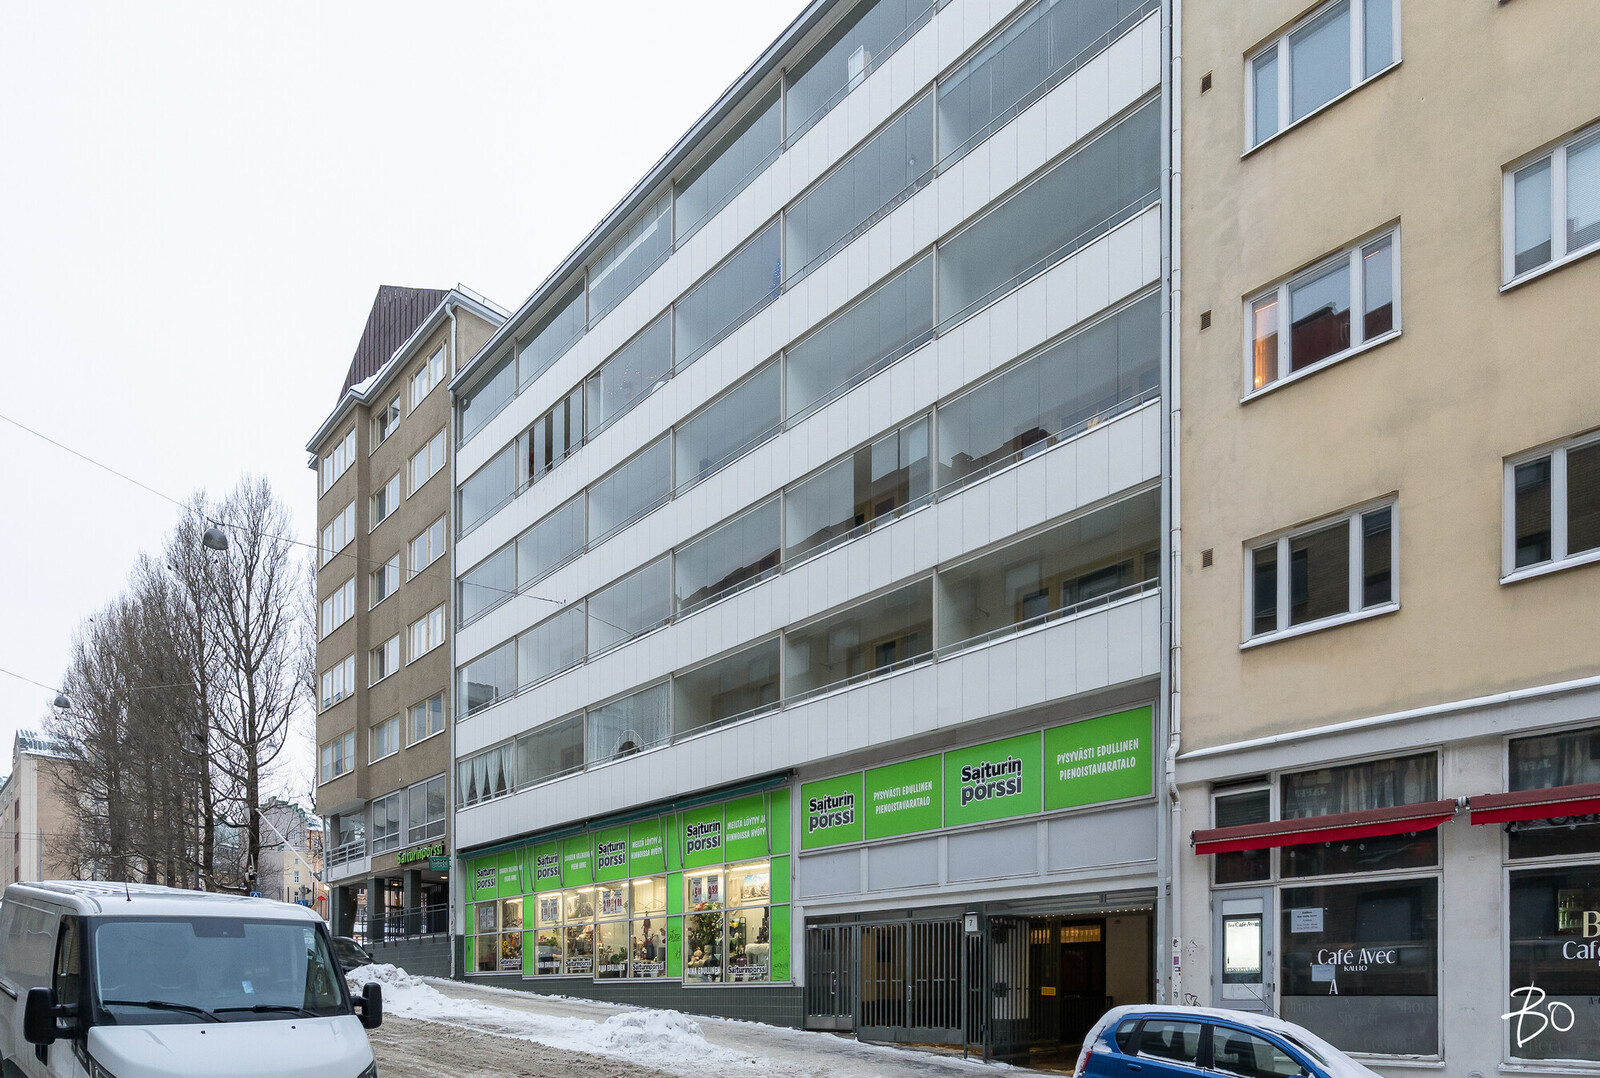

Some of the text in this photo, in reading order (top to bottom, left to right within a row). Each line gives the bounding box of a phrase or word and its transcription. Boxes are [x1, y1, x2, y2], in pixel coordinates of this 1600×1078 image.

[1057, 738, 1139, 765] PYSYVÄSTI EDULLINEN
[961, 755, 1022, 783] Saiturin
[1059, 756, 1136, 781] PIENOISTAVARATALO
[809, 790, 854, 812] Saiturin
[873, 781, 933, 801] PYSYVÄSTI EDULLINEN
[876, 796, 930, 815] PIENOISTAVARATALO
[687, 819, 721, 837] Saiturin
[598, 840, 625, 856] Saiturin
[1318, 948, 1396, 965] Café Avec
[1562, 940, 1600, 960] Caf
